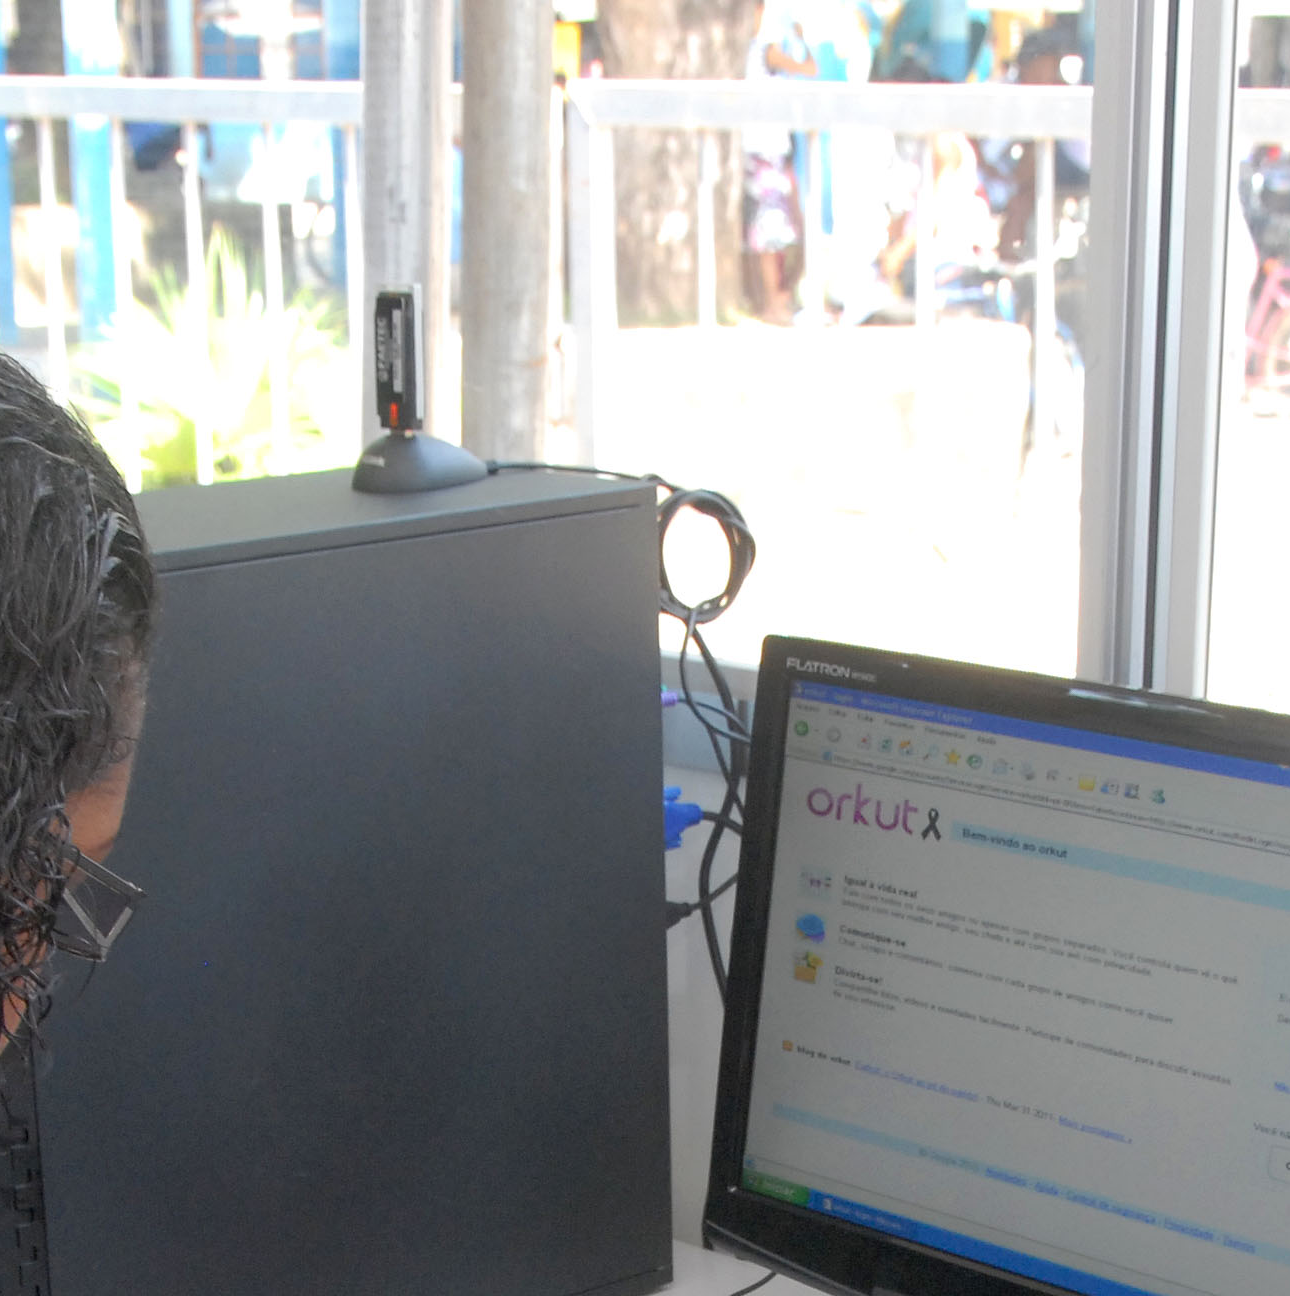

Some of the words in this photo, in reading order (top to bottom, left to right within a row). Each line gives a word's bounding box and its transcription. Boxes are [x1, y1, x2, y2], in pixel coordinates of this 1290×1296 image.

[786, 656, 850, 678] FLATRON
[807, 783, 918, 836] orkut
[962, 828, 1020, 850] Bem-vindo
[1022, 840, 1036, 853] ao
[1037, 844, 1067, 859] orkut
[844, 875, 866, 888] Igual
[877, 883, 896, 895] vida
[898, 887, 917, 899] real
[839, 924, 906, 948] Comunique-se
